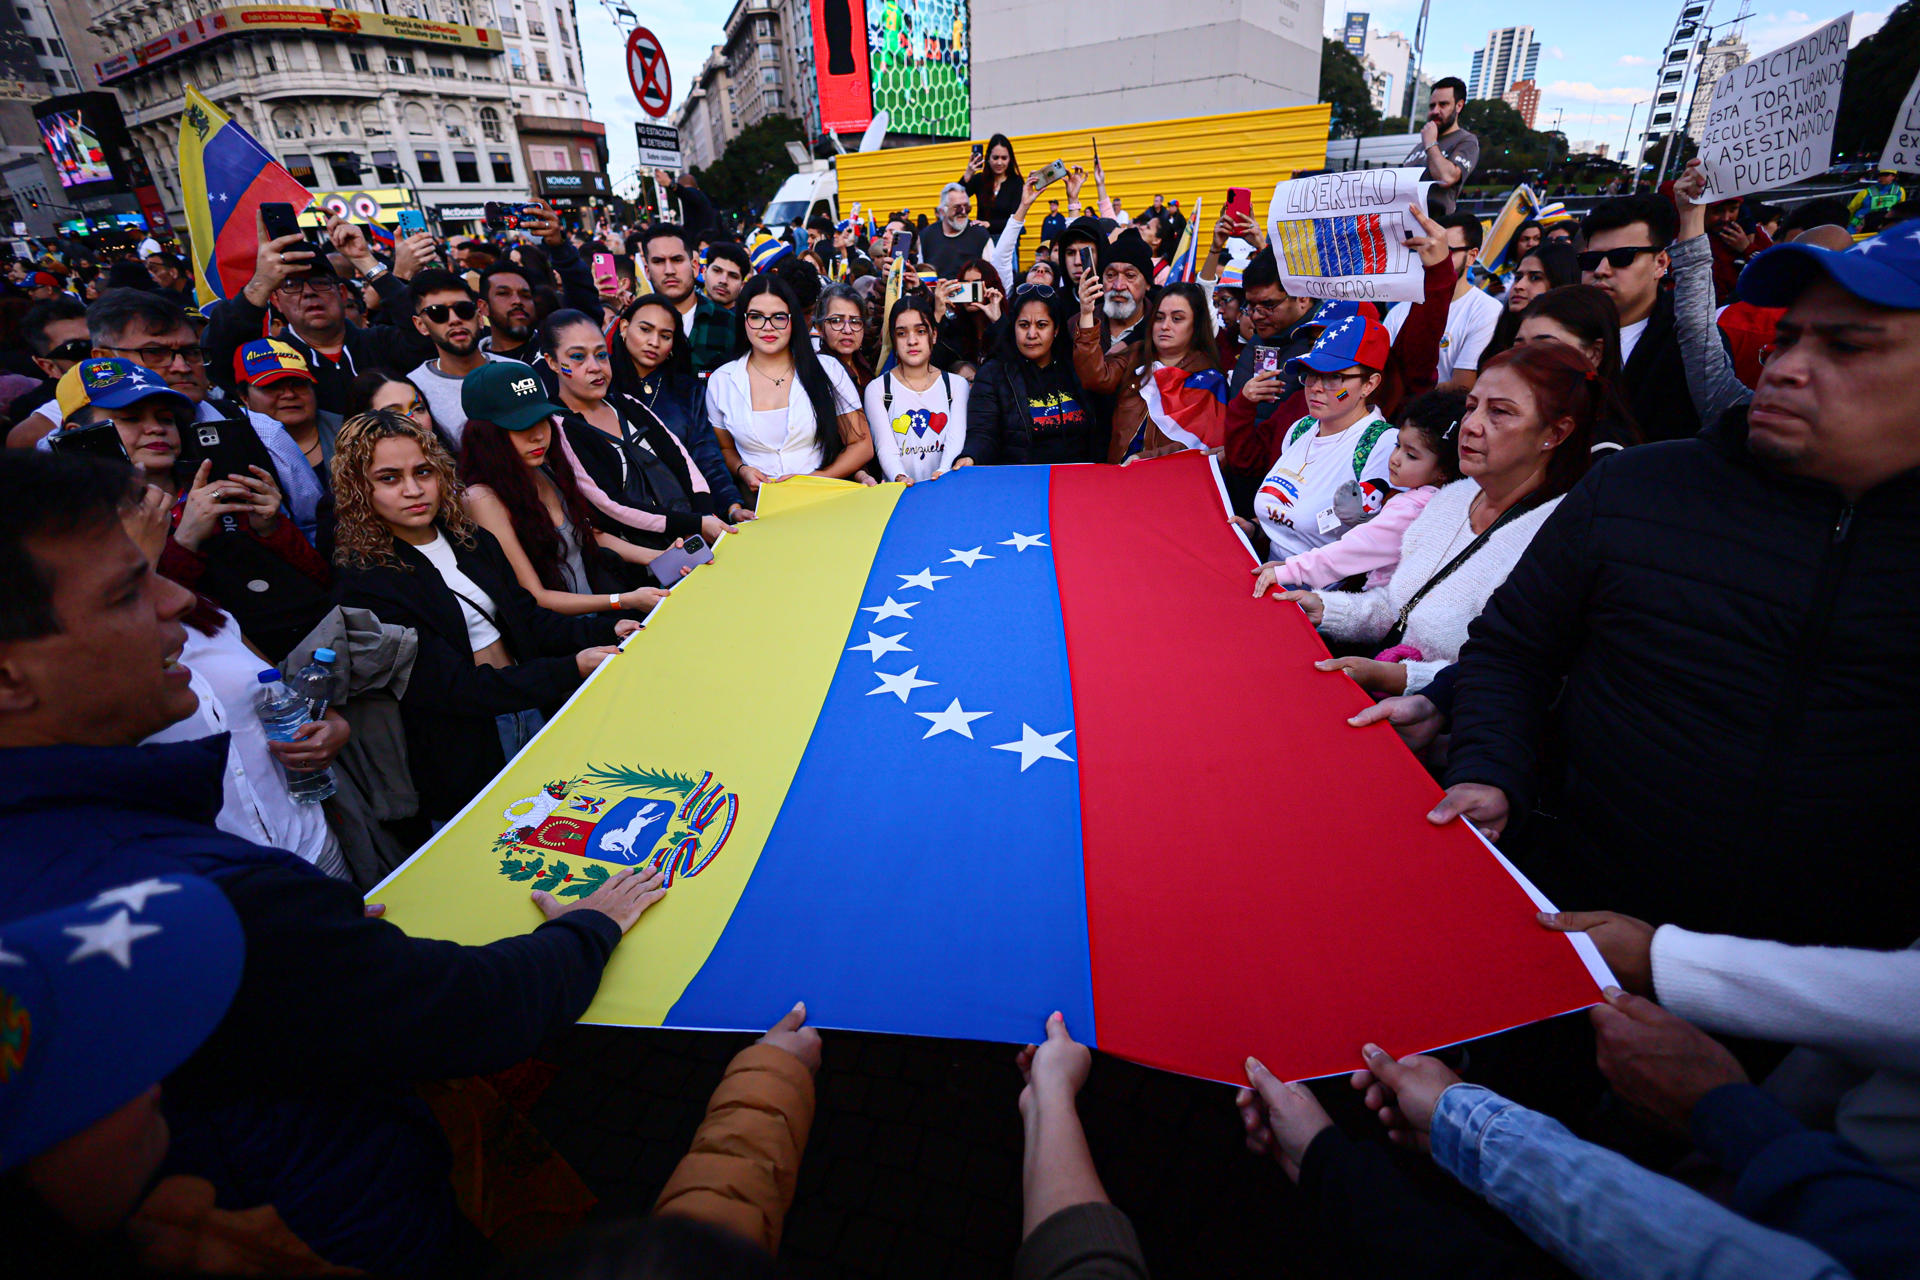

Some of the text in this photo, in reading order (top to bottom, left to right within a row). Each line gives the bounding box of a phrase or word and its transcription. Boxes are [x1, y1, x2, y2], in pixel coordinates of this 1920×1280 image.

[1716, 20, 1849, 100] LA DICTADURA
[1703, 90, 1826, 149] SECUESTRANDO
[1709, 96, 1743, 127] ESTÁ
[1702, 110, 1834, 171] Y ASESINANDO
[1287, 170, 1397, 213] LIBERTAD
[1701, 146, 1811, 198] AL PUEBLO
